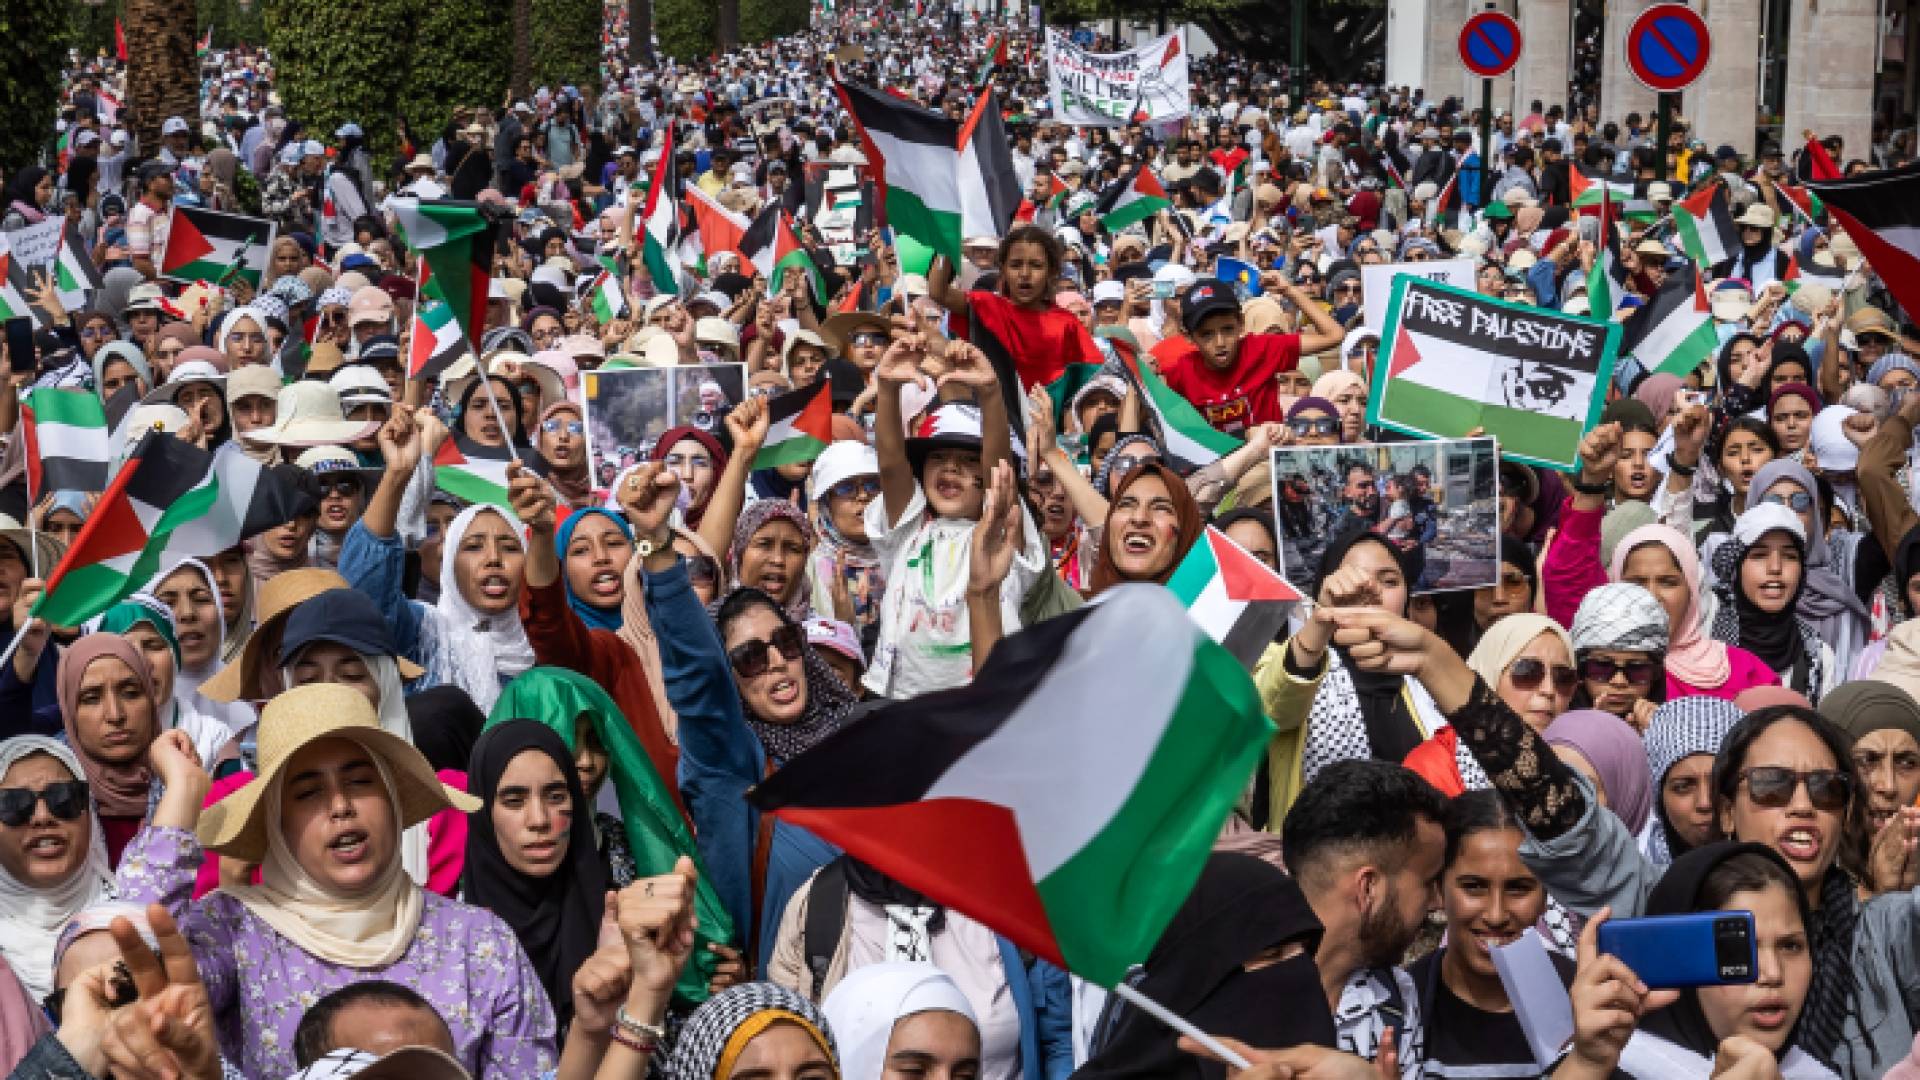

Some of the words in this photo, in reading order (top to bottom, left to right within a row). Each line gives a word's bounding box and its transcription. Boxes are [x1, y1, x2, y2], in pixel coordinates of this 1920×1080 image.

[1053, 55, 1135, 81] PALTINE
[1056, 69, 1105, 97] WILL
[1109, 84, 1133, 100] BE
[1405, 290, 1466, 327] FREE
